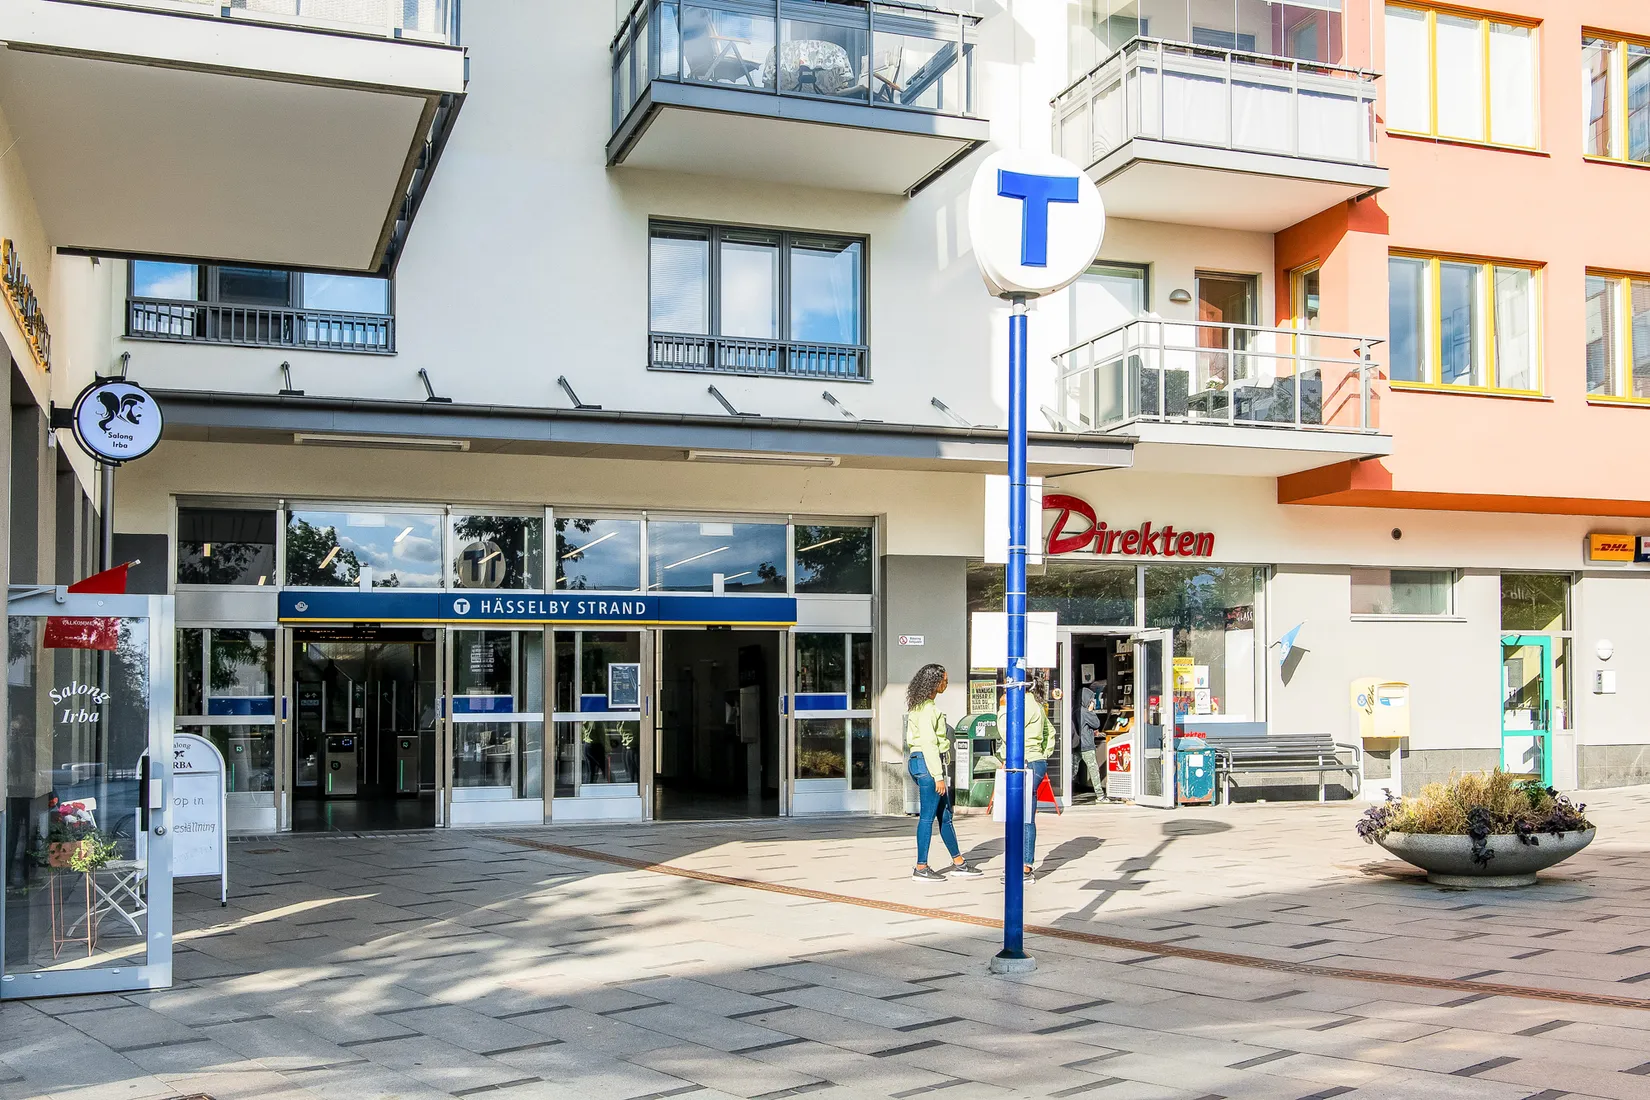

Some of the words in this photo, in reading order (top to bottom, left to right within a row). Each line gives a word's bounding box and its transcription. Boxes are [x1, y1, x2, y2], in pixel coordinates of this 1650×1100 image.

[997, 169, 1080, 267] T
[108, 432, 134, 441] Salong
[113, 441, 128, 449] Irba
[1042, 494, 1215, 557] Direkten
[1600, 543, 1629, 552] DHL
[481, 598, 570, 614] HÄSSELBY
[578, 601, 646, 615] STRAND
[49, 681, 110, 706] Salong
[61, 708, 100, 724] Irba
[173, 742, 191, 750] along
[173, 798, 189, 807] op
[194, 797, 205, 805] in
[173, 823, 216, 834] eställning
